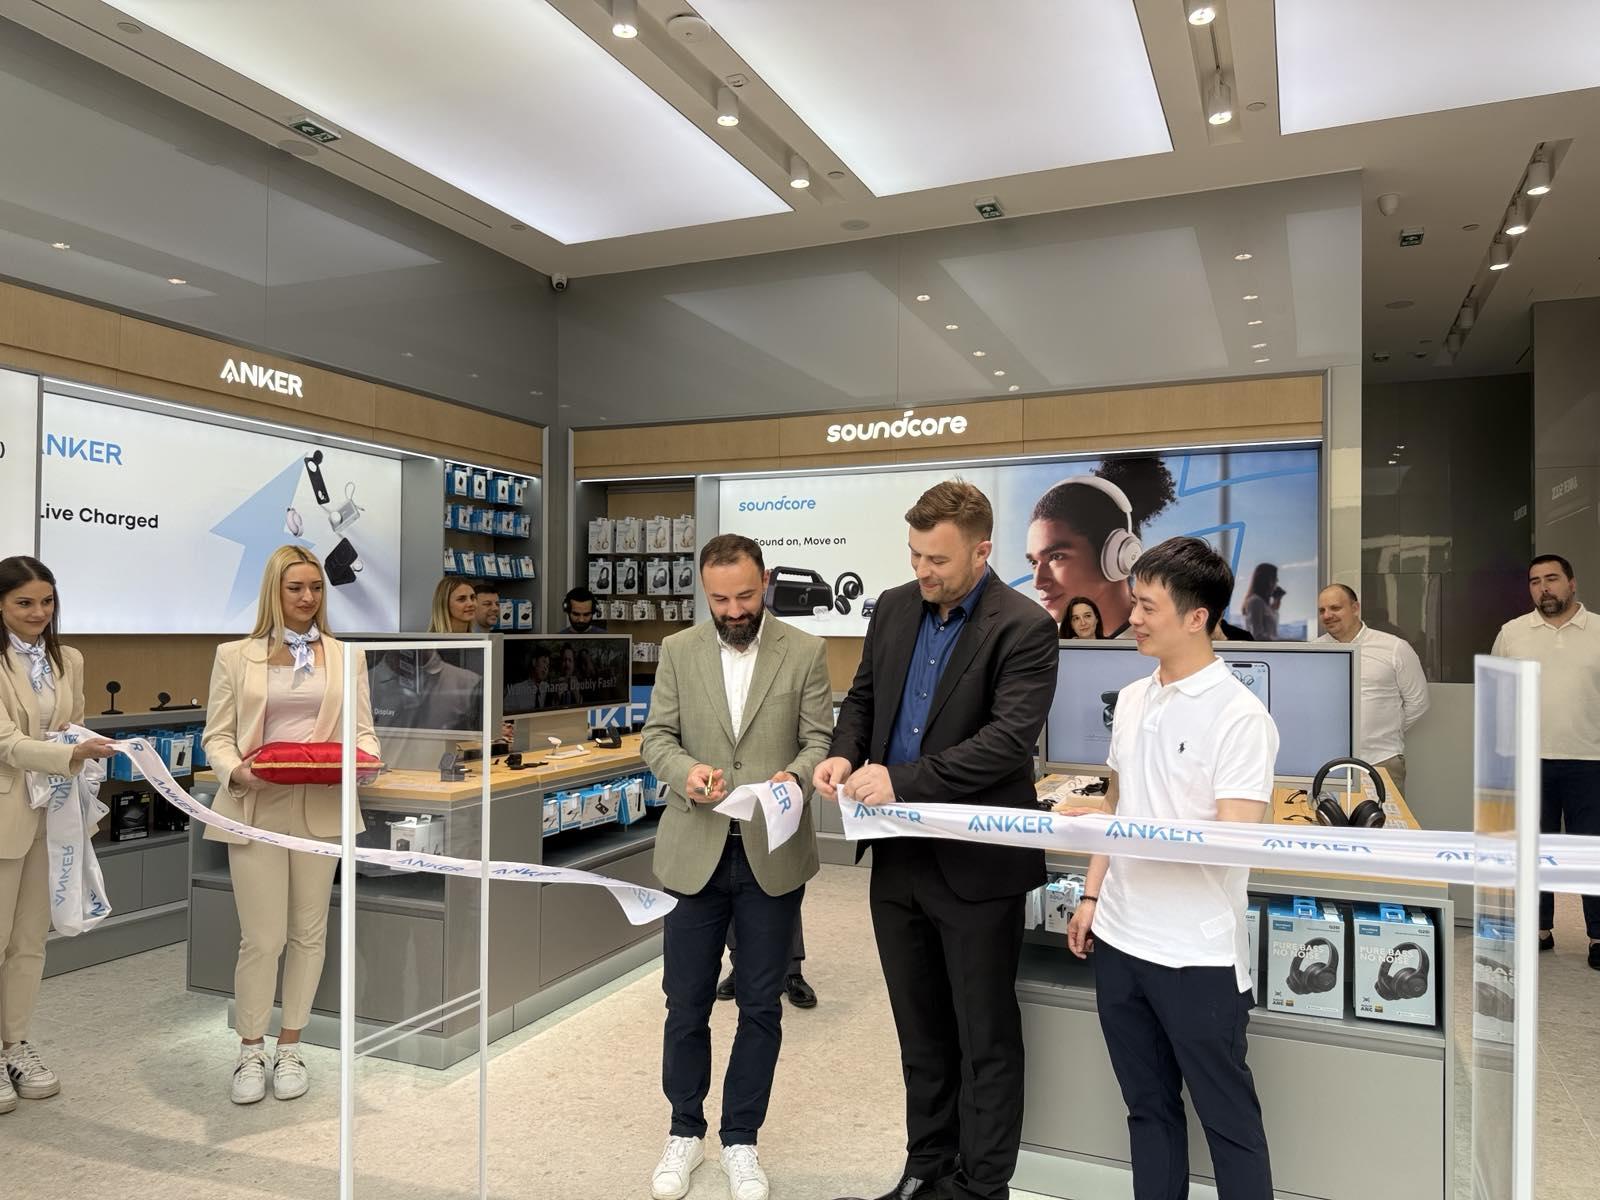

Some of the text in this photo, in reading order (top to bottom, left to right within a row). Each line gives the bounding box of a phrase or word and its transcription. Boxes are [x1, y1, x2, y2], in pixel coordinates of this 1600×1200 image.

[220, 358, 303, 398] ANKER
[826, 409, 968, 443] soundcore
[42, 433, 122, 465] NKER
[738, 495, 816, 512] soundcore
[41, 503, 159, 530] ive Charged
[753, 536, 847, 547] Sound on, Move on
[597, 676, 617, 689] Fast?
[968, 815, 1054, 833] ANKER
[1105, 820, 1205, 843] ANKER
[1272, 941, 1325, 953] PURE BASS
[1272, 948, 1321, 960] NO NOISE
[1360, 945, 1414, 958] PURE BASS
[1360, 953, 1409, 965] NO NOISE
